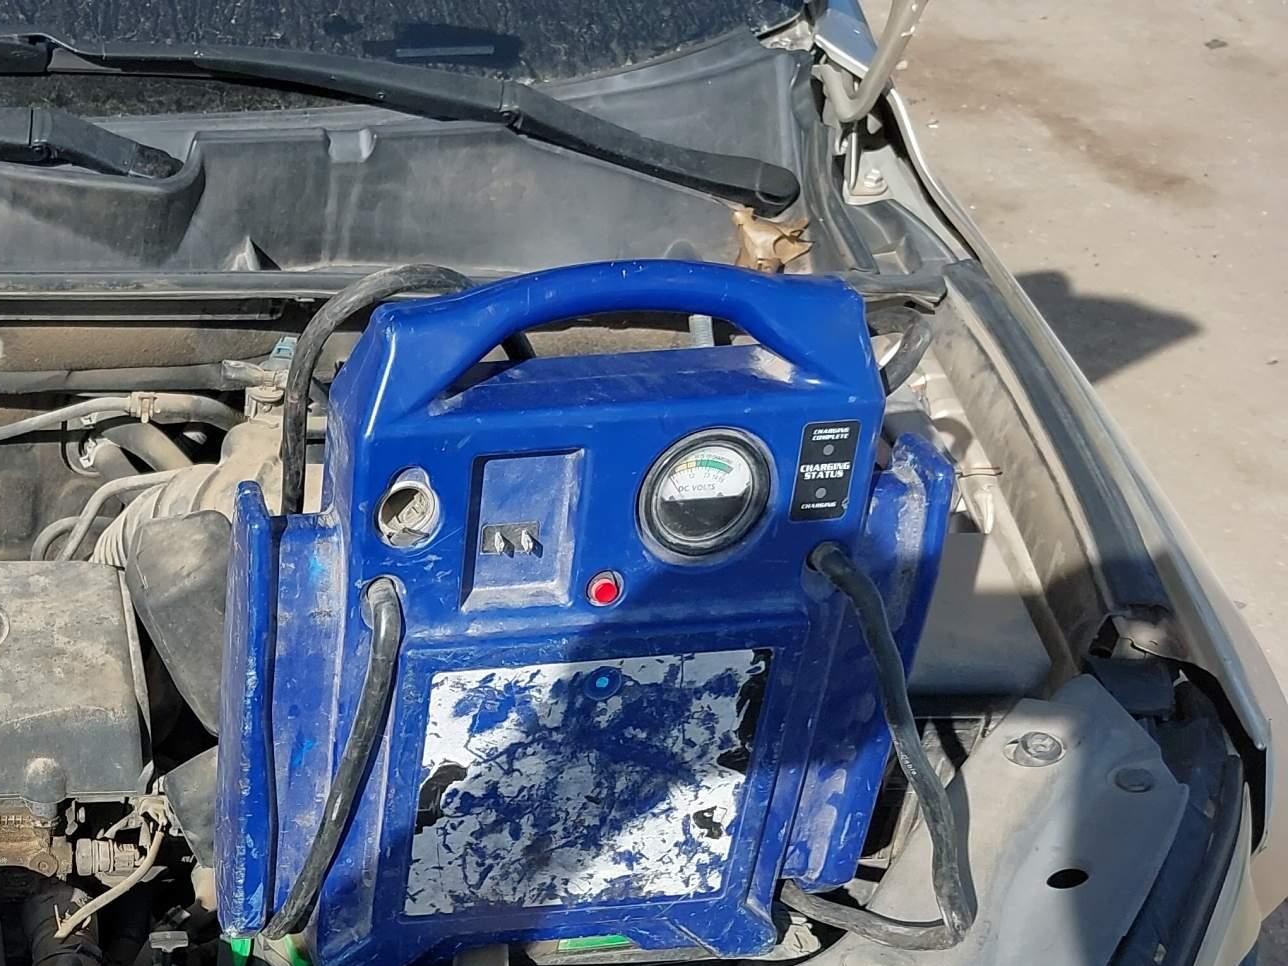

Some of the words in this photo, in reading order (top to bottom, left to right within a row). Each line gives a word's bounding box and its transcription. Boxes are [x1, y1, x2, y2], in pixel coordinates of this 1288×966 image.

[812, 433, 849, 441] COMPLETE
[800, 461, 851, 473] CHARGING
[804, 470, 844, 480] STATUS
